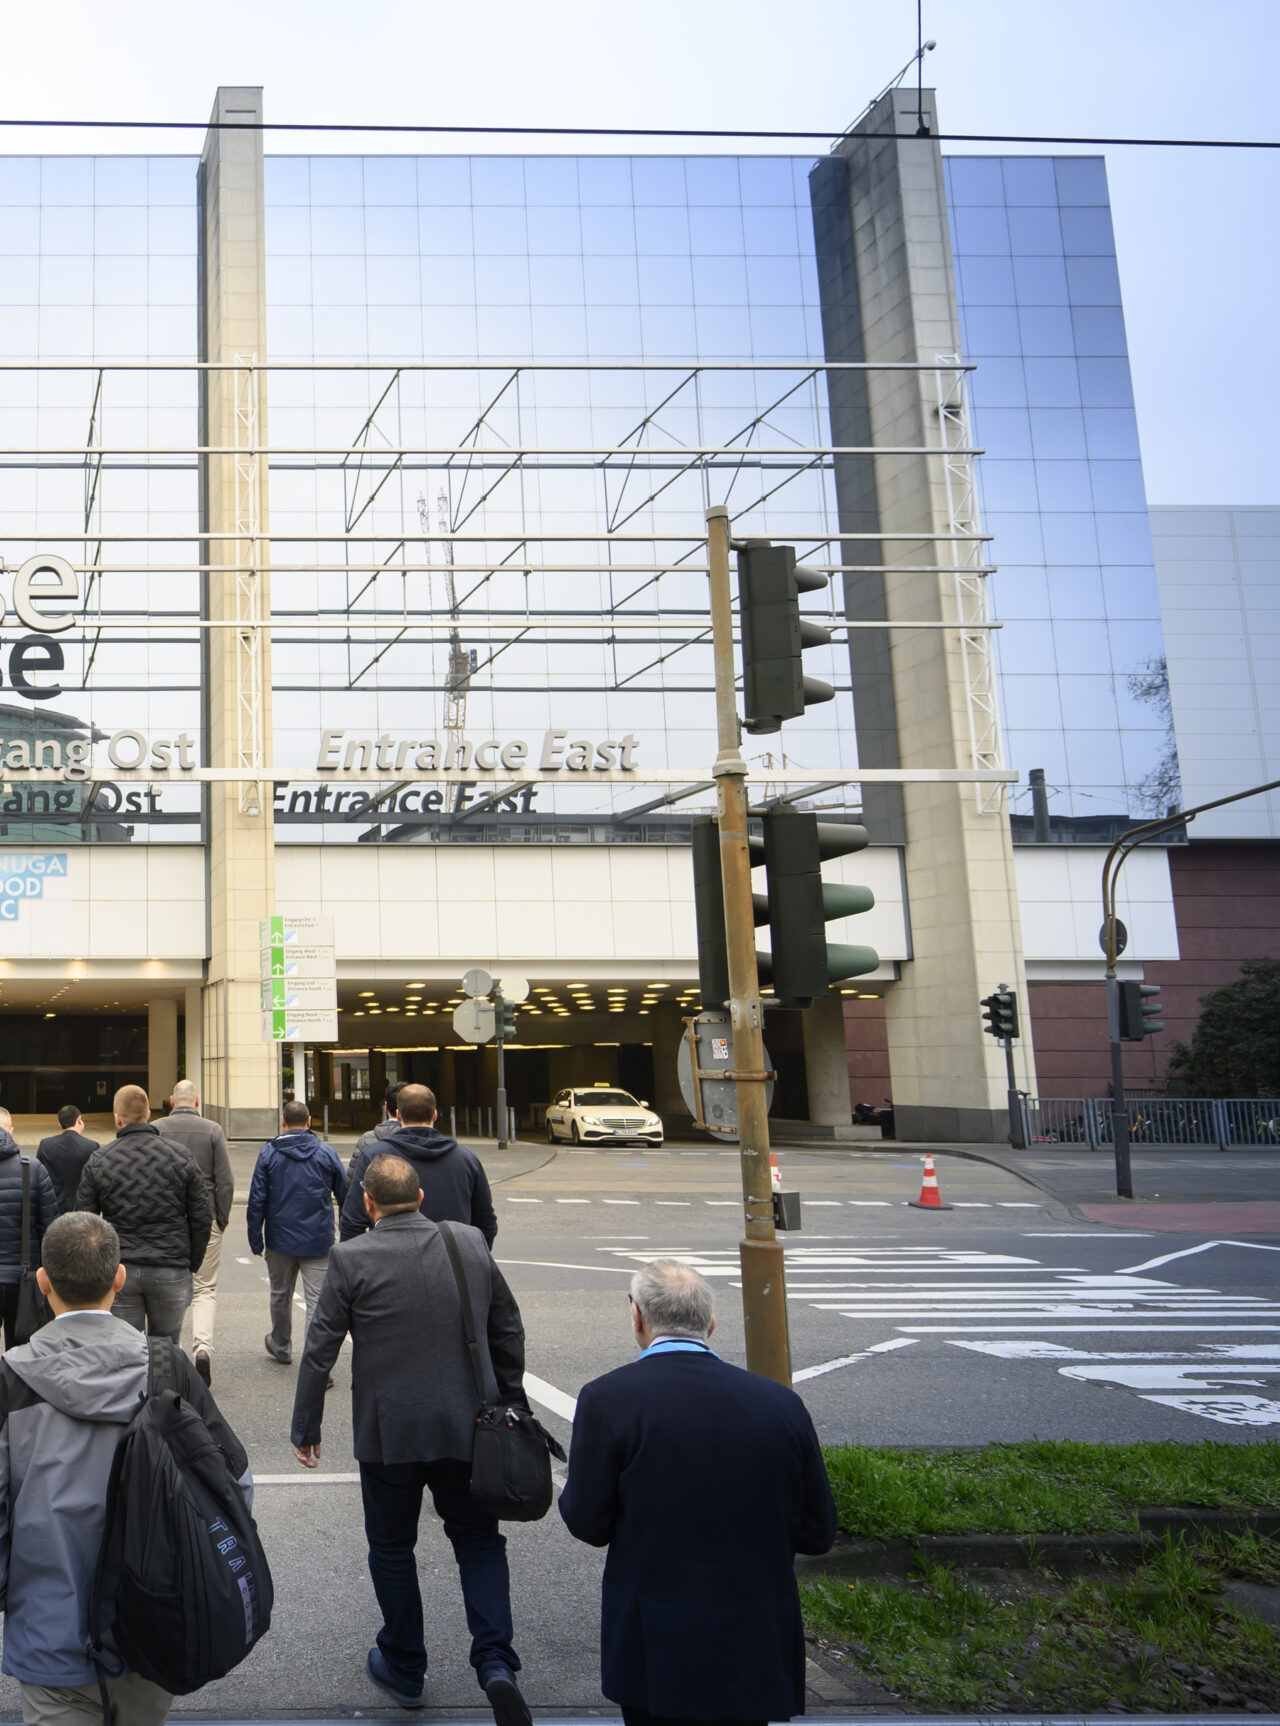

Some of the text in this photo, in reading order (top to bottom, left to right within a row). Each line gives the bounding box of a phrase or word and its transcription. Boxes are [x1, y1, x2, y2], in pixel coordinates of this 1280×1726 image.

[108, 729, 196, 769] Ost
[317, 729, 640, 771] Entrance East
